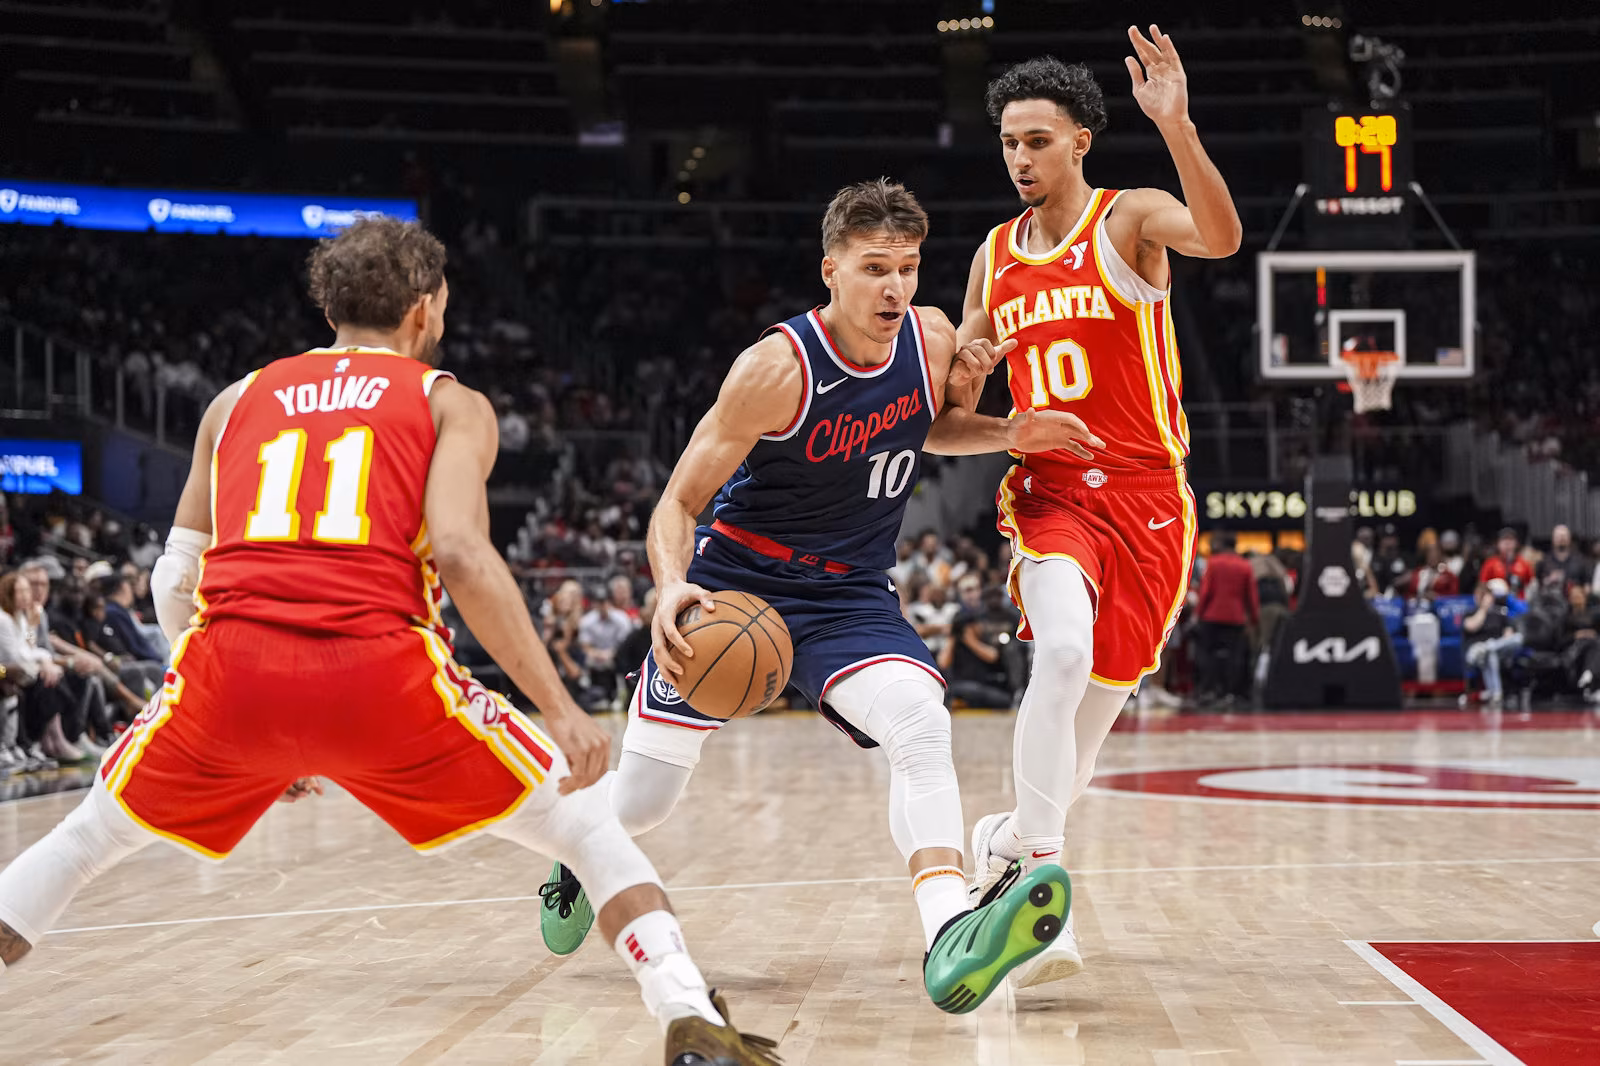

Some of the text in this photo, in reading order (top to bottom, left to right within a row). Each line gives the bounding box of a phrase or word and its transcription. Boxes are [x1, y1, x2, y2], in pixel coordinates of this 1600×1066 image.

[992, 285, 1116, 343] ATLANTA
[273, 375, 390, 417] YOUNG
[1025, 338, 1094, 408] 10
[805, 388, 922, 463] Clippers
[243, 425, 374, 546] 11
[866, 449, 916, 499] 10
[1082, 472, 1108, 484] HAWKS
[1293, 636, 1380, 664] KIA
